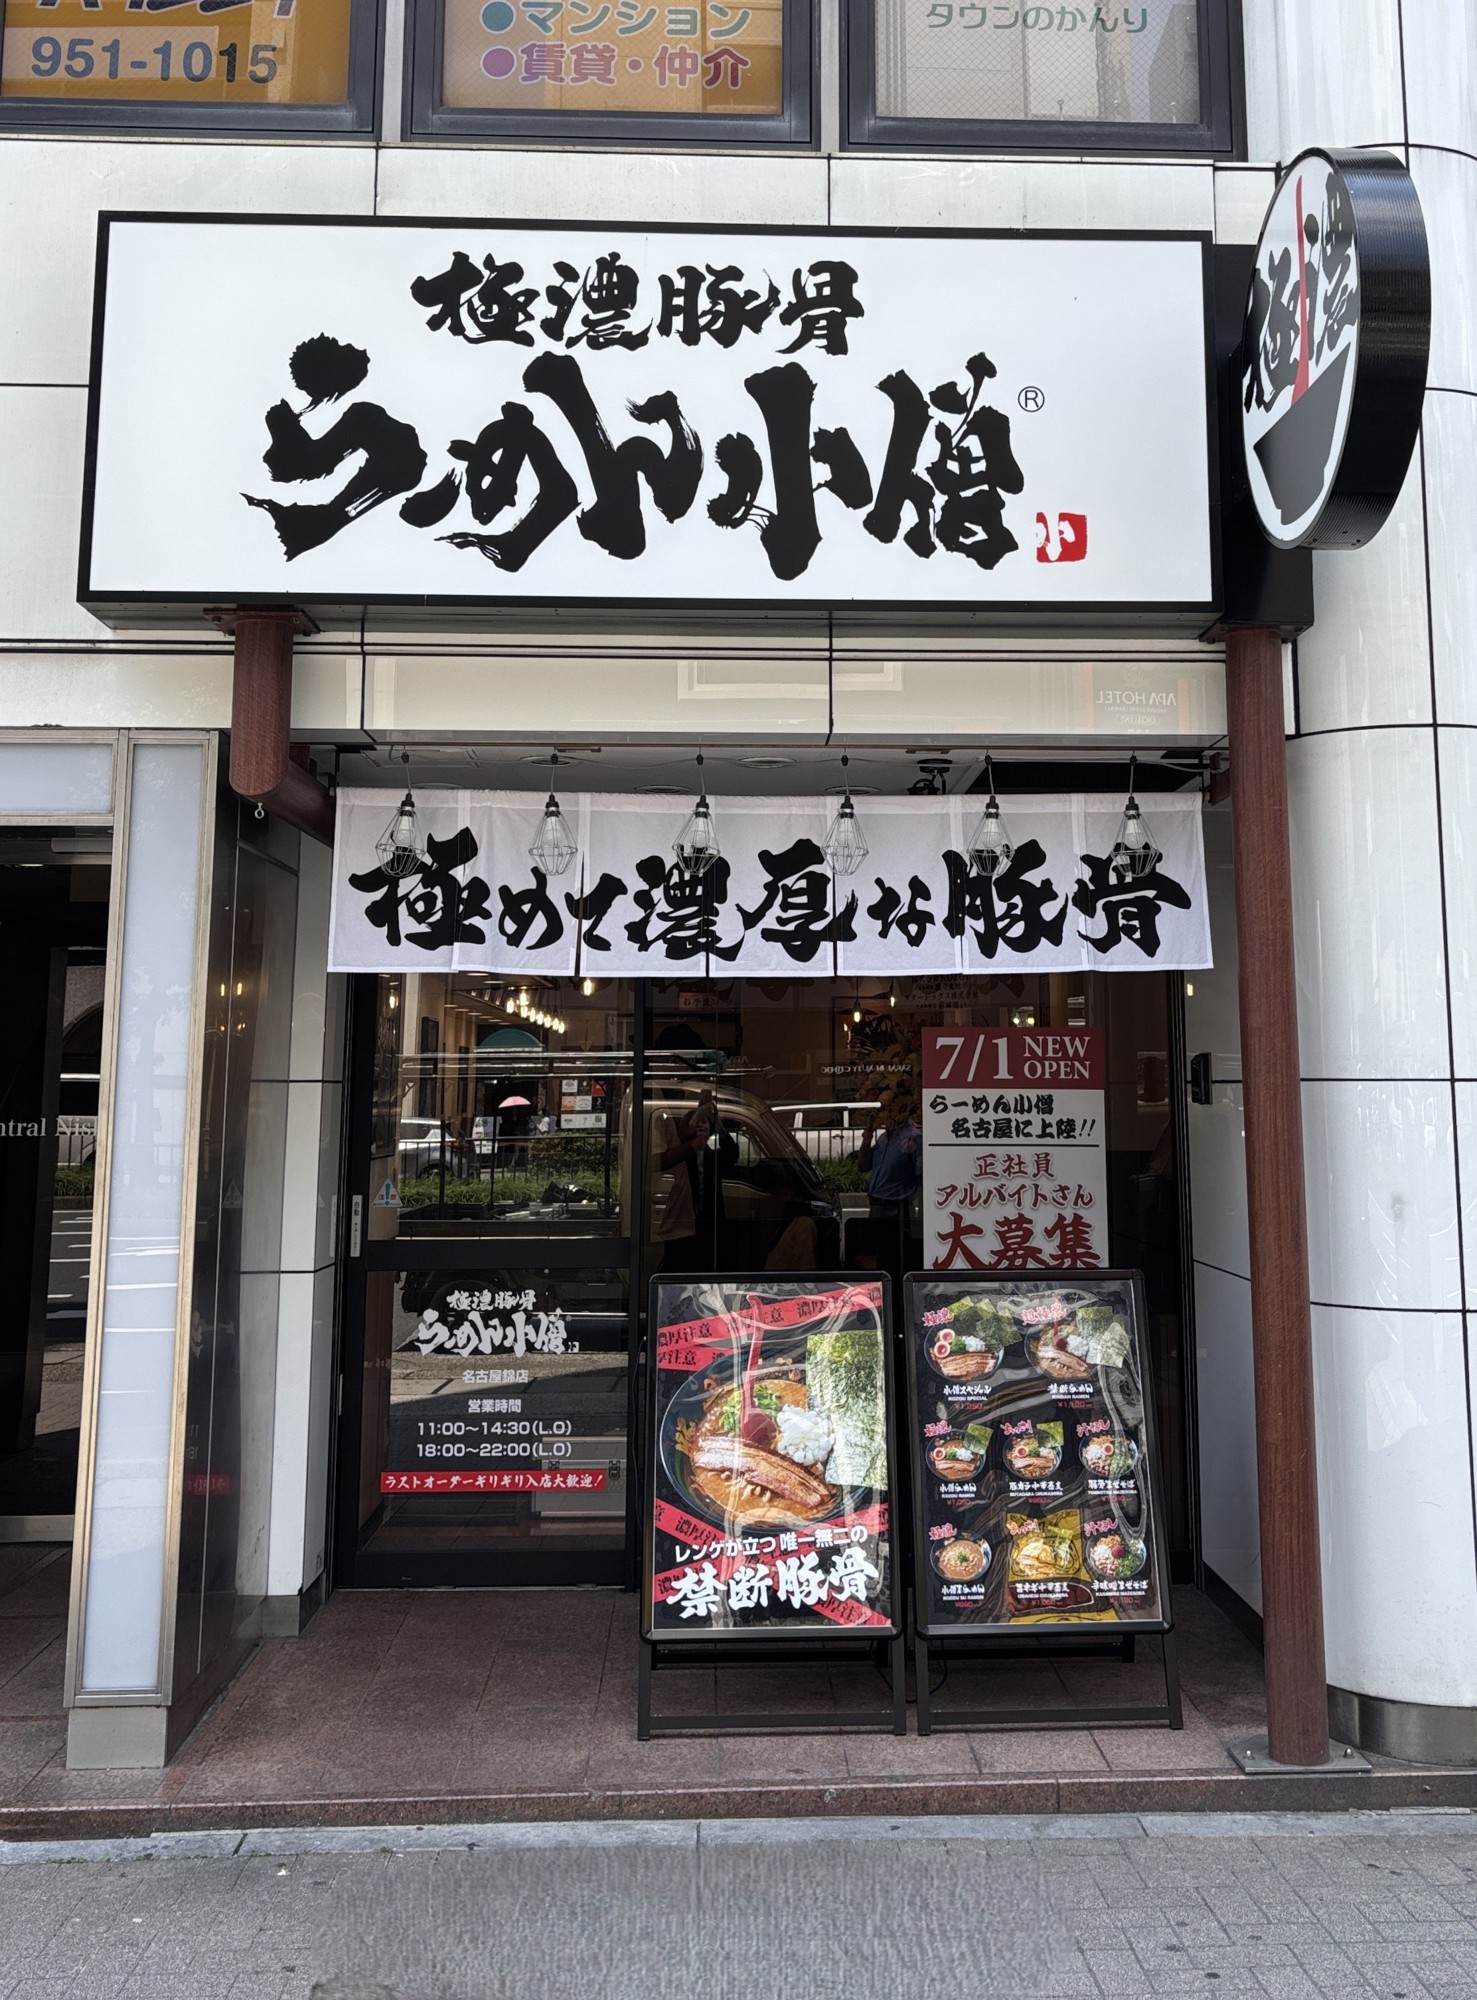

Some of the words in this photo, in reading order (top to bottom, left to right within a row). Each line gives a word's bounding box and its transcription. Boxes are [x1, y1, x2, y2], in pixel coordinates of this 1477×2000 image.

[520, 1, 751, 38] マンション
[925, 2, 1150, 33] タウンのかんり
[31, 36, 278, 83] 951-1015
[520, 43, 750, 88] 賃貸・仲介
[411, 251, 864, 356] 極濃豚骨
[348, 826, 1192, 960] 極めて濃厚な豚骨
[935, 1034, 1014, 1082] 7/1
[1023, 1035, 1091, 1057] NEW
[1023, 1061, 1091, 1080] OPEN
[929, 1094, 1054, 1116] らーめん小僧
[974, 1152, 1055, 1179] 正社員
[936, 1183, 1094, 1210] アルバイトさん
[932, 1211, 1102, 1269] 大募集
[462, 1369, 529, 1384] 名古屋錦店
[468, 1399, 522, 1414] 営業時間
[666, 1546, 879, 1619] 禁断豚骨
